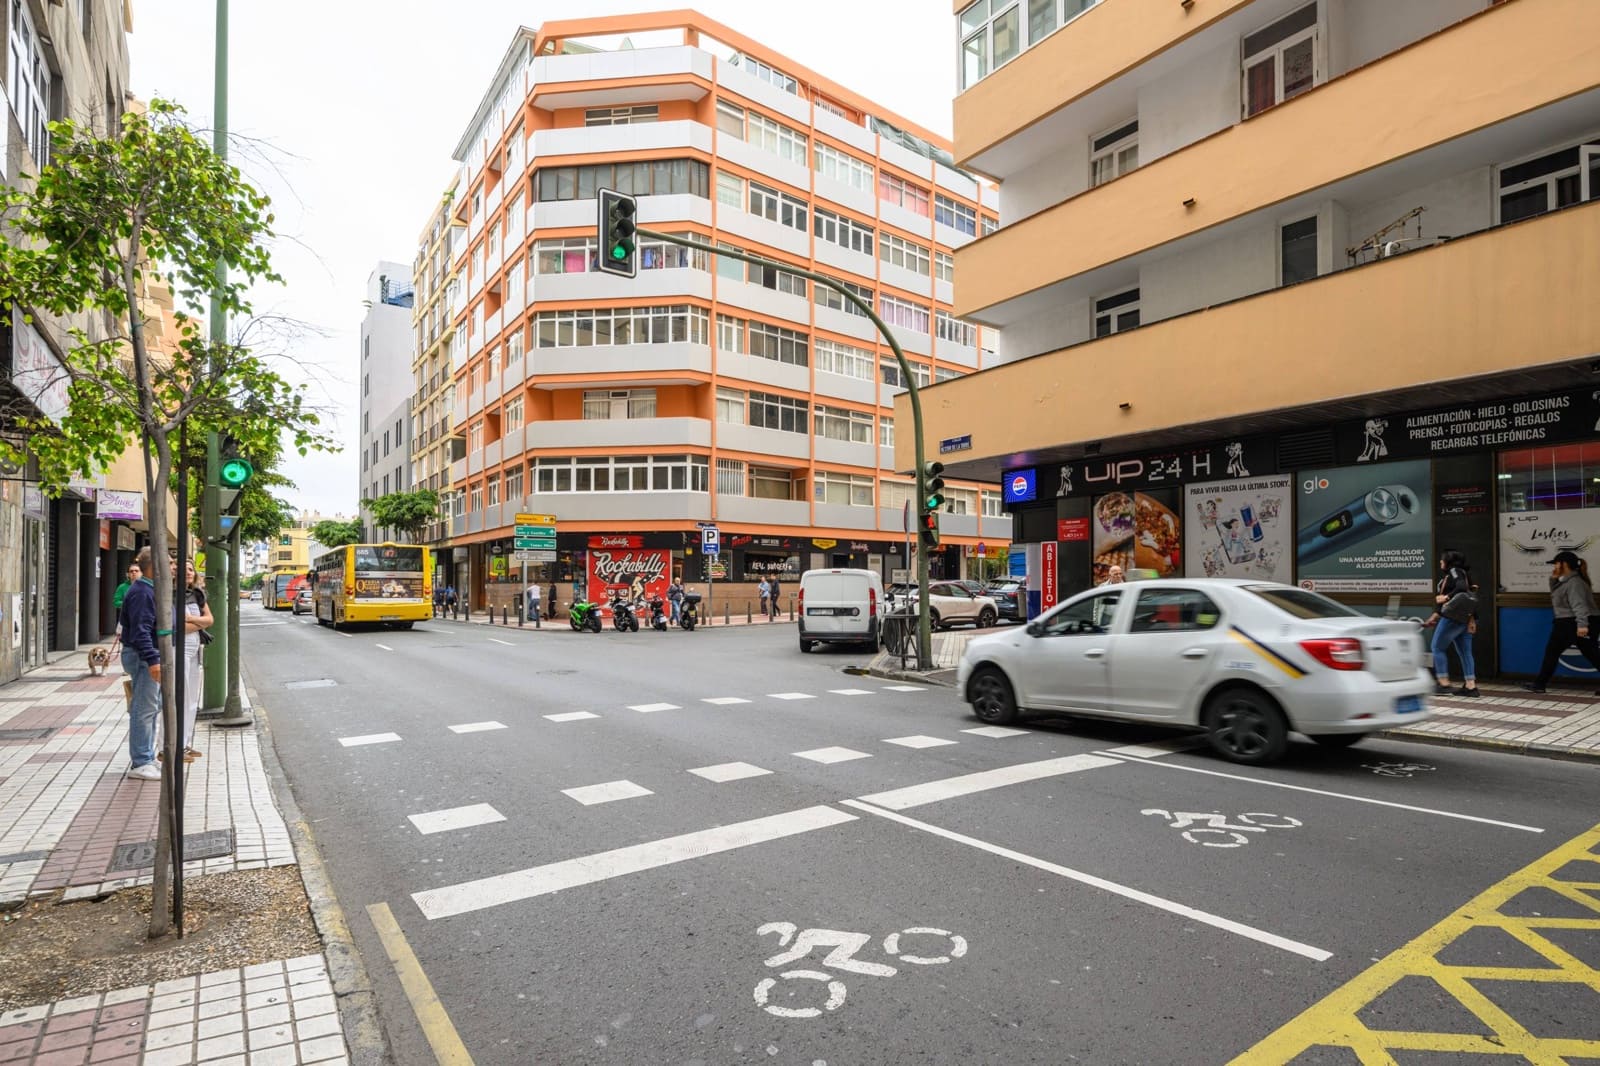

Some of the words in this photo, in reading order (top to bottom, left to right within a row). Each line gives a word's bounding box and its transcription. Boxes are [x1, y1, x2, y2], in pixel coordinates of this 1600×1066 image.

[1406, 409, 1471, 428] ALIMENTACIÓN
[1477, 405, 1506, 419] HIELO
[1513, 396, 1571, 414] GOLOSINAS
[1409, 427, 1444, 440] PRENSA
[1450, 418, 1508, 435] FOTOCOPIAS
[1514, 411, 1561, 427] REGALOS
[1431, 436, 1479, 451] RECARGAS
[1480, 427, 1546, 446] TELEFÓNICAS
[1148, 457, 1183, 481] 24
[1193, 453, 1211, 476] H
[1190, 488, 1204, 496] PARA
[1205, 486, 1220, 494] VIVIR
[1221, 485, 1238, 493] HASTA
[1247, 482, 1269, 491] ÚLTIMA
[1269, 480, 1290, 488] STORY.
[1303, 475, 1329, 494] glo
[706, 531, 716, 543] P
[593, 551, 666, 584] Rockabilly
[1046, 543, 1054, 603] ABIERTO
